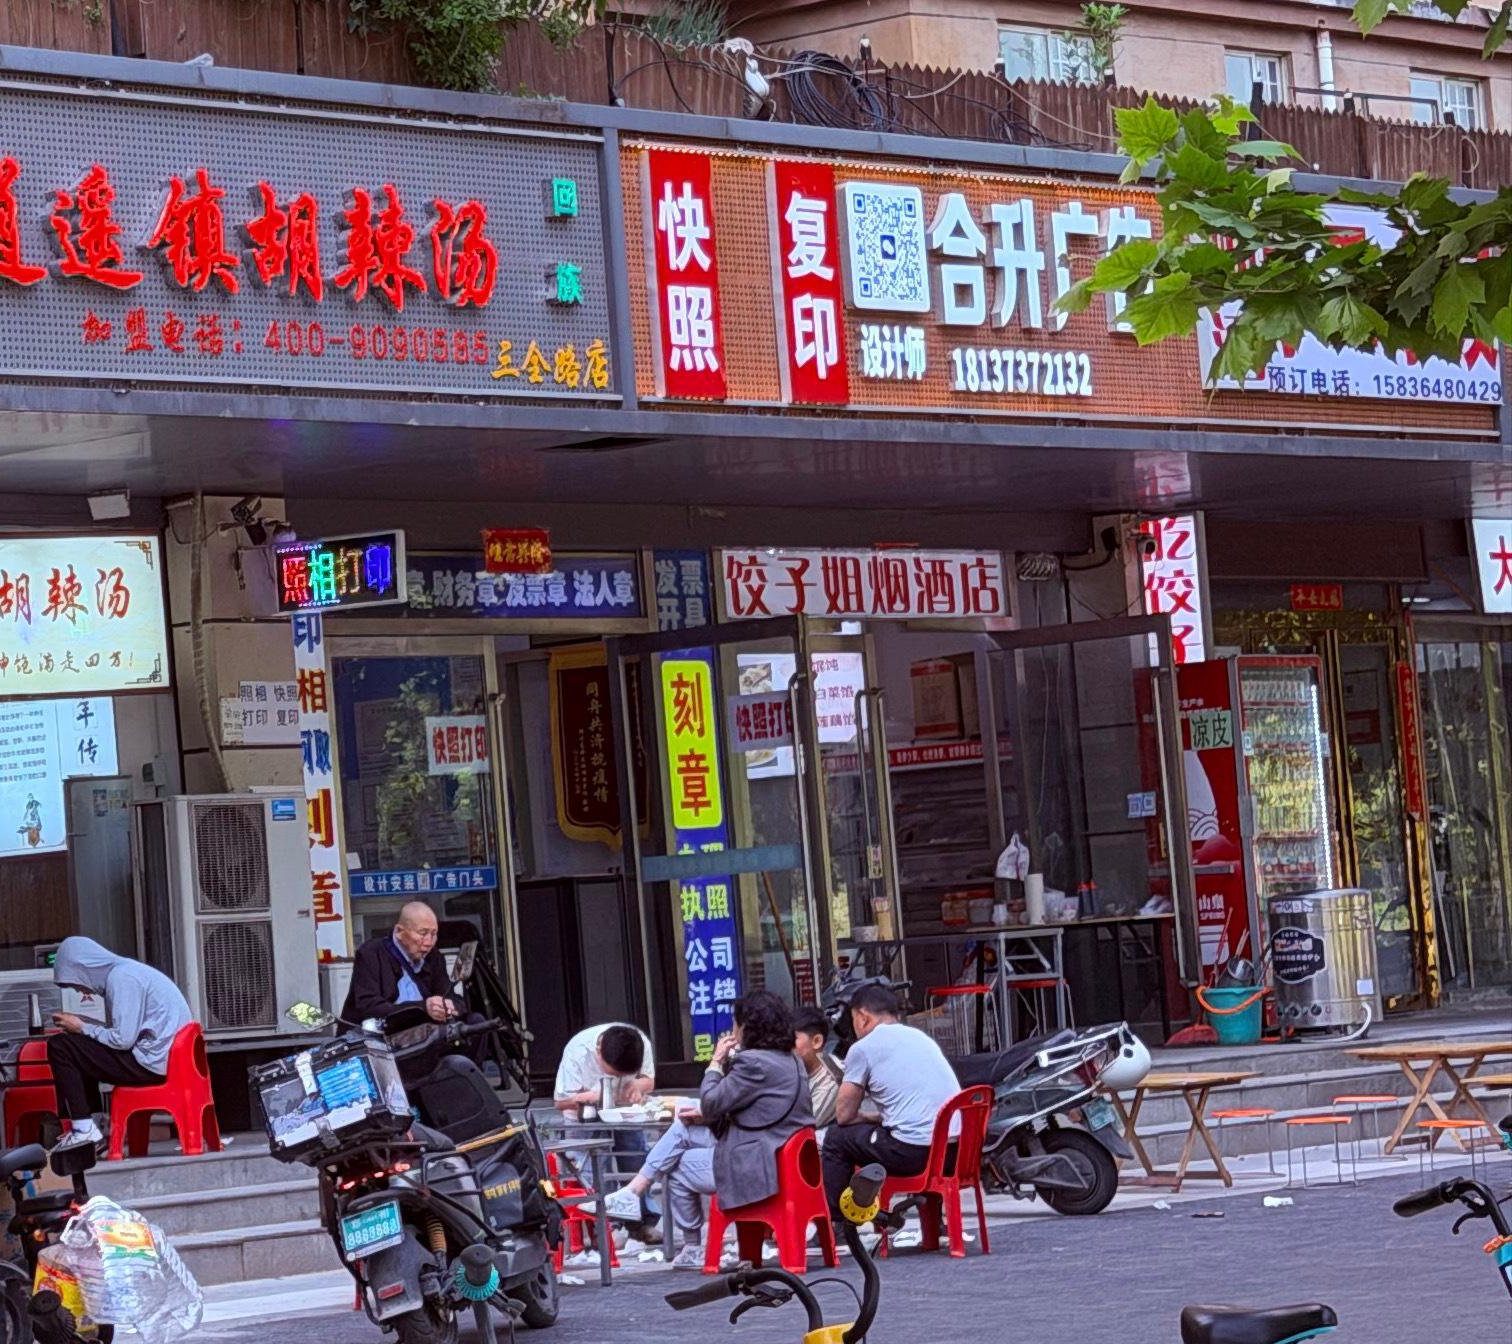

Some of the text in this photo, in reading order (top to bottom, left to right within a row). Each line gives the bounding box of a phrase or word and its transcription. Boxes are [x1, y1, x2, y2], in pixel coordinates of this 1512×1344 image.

[551, 177, 584, 306] 回族
[658, 181, 720, 373] 快照
[785, 191, 839, 380] 复印
[491, 340, 611, 390] 三全路店
[860, 325, 927, 381] 设计师
[952, 347, 1092, 397] 18137372132
[282, 544, 392, 604] 照相打印
[727, 555, 1001, 617] 饺子姐烟酒店
[433, 725, 487, 764] 快照打印
[673, 671, 713, 817] 刻章
[1192, 712, 1230, 749] 凉皮
[681, 884, 730, 922] 执照
[685, 937, 733, 972] 公司
